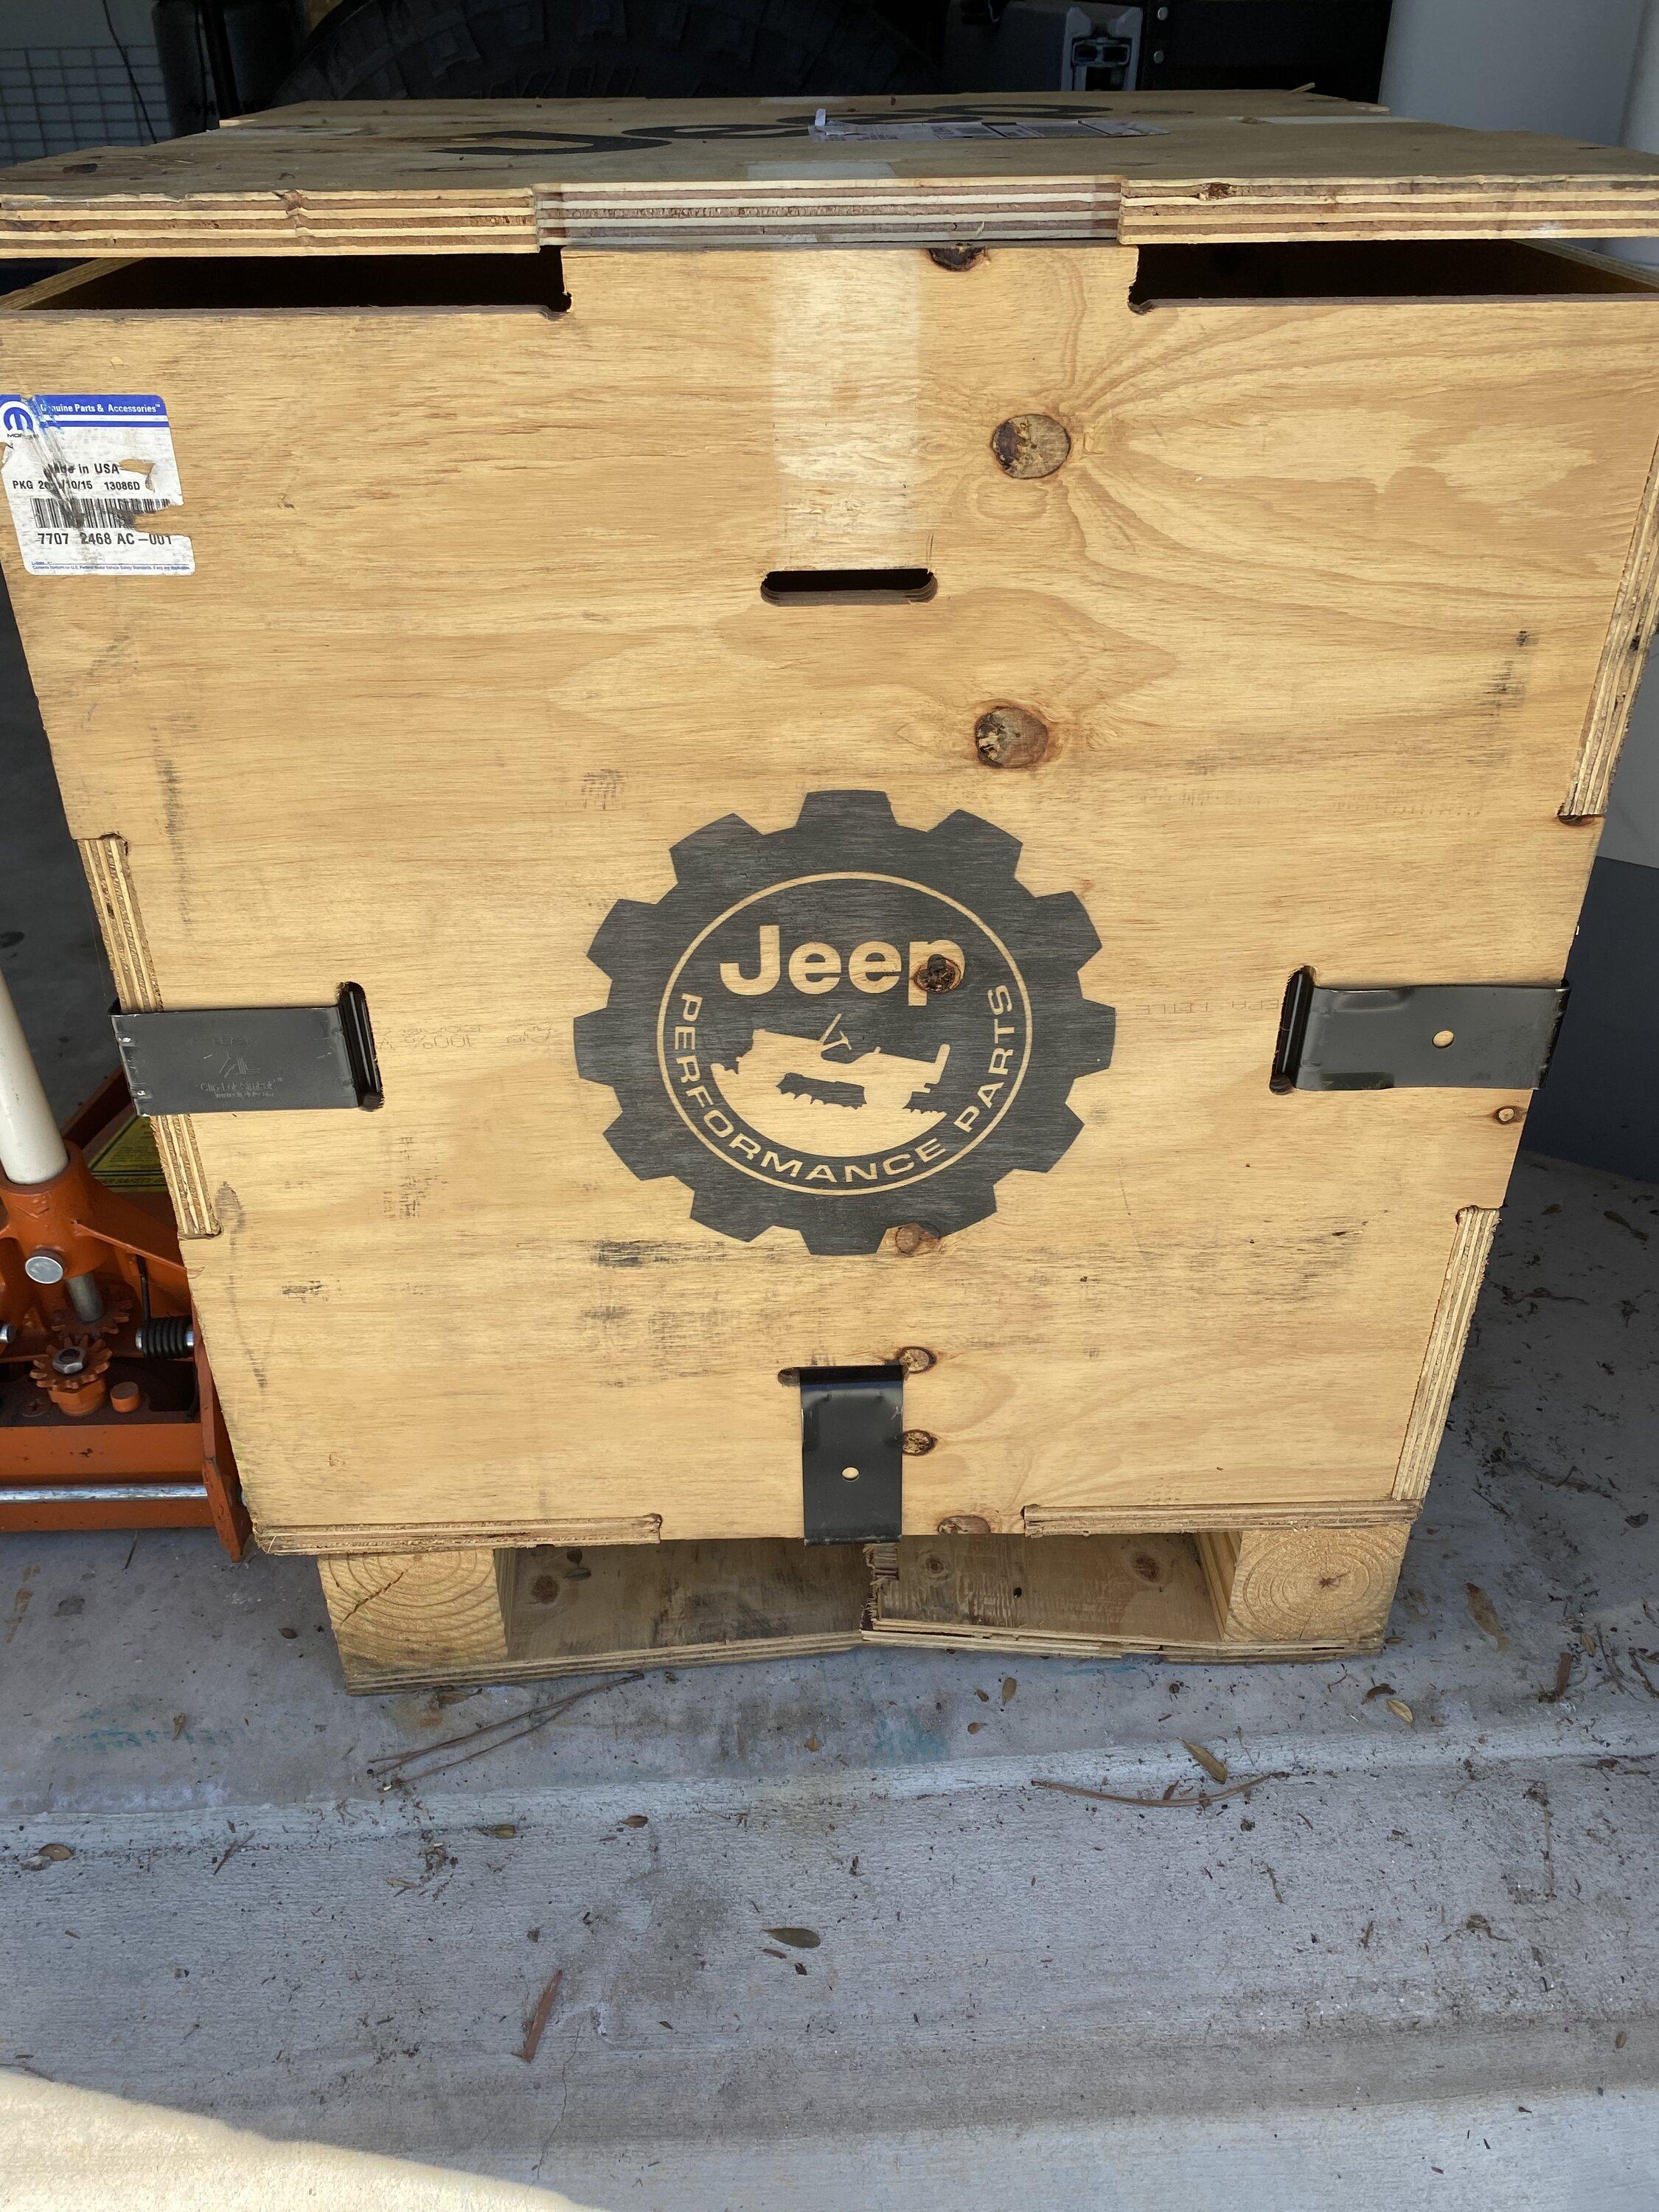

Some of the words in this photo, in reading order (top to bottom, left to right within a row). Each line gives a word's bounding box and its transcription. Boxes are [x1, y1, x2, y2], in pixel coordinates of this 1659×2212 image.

[75, 404, 96, 412] Parts
[97, 404, 104, 412] &
[78, 464, 89, 474] in
[94, 463, 119, 474] USA
[13, 480, 33, 490] PKG
[104, 481, 140, 490] 13086D
[38, 533, 69, 545] 7707
[80, 532, 112, 545] 2468
[117, 533, 134, 545] AC
[720, 925, 965, 1006] Jeep
[675, 993, 946, 1183] PERFORMANCE
[953, 985, 1015, 1133] PARTS
